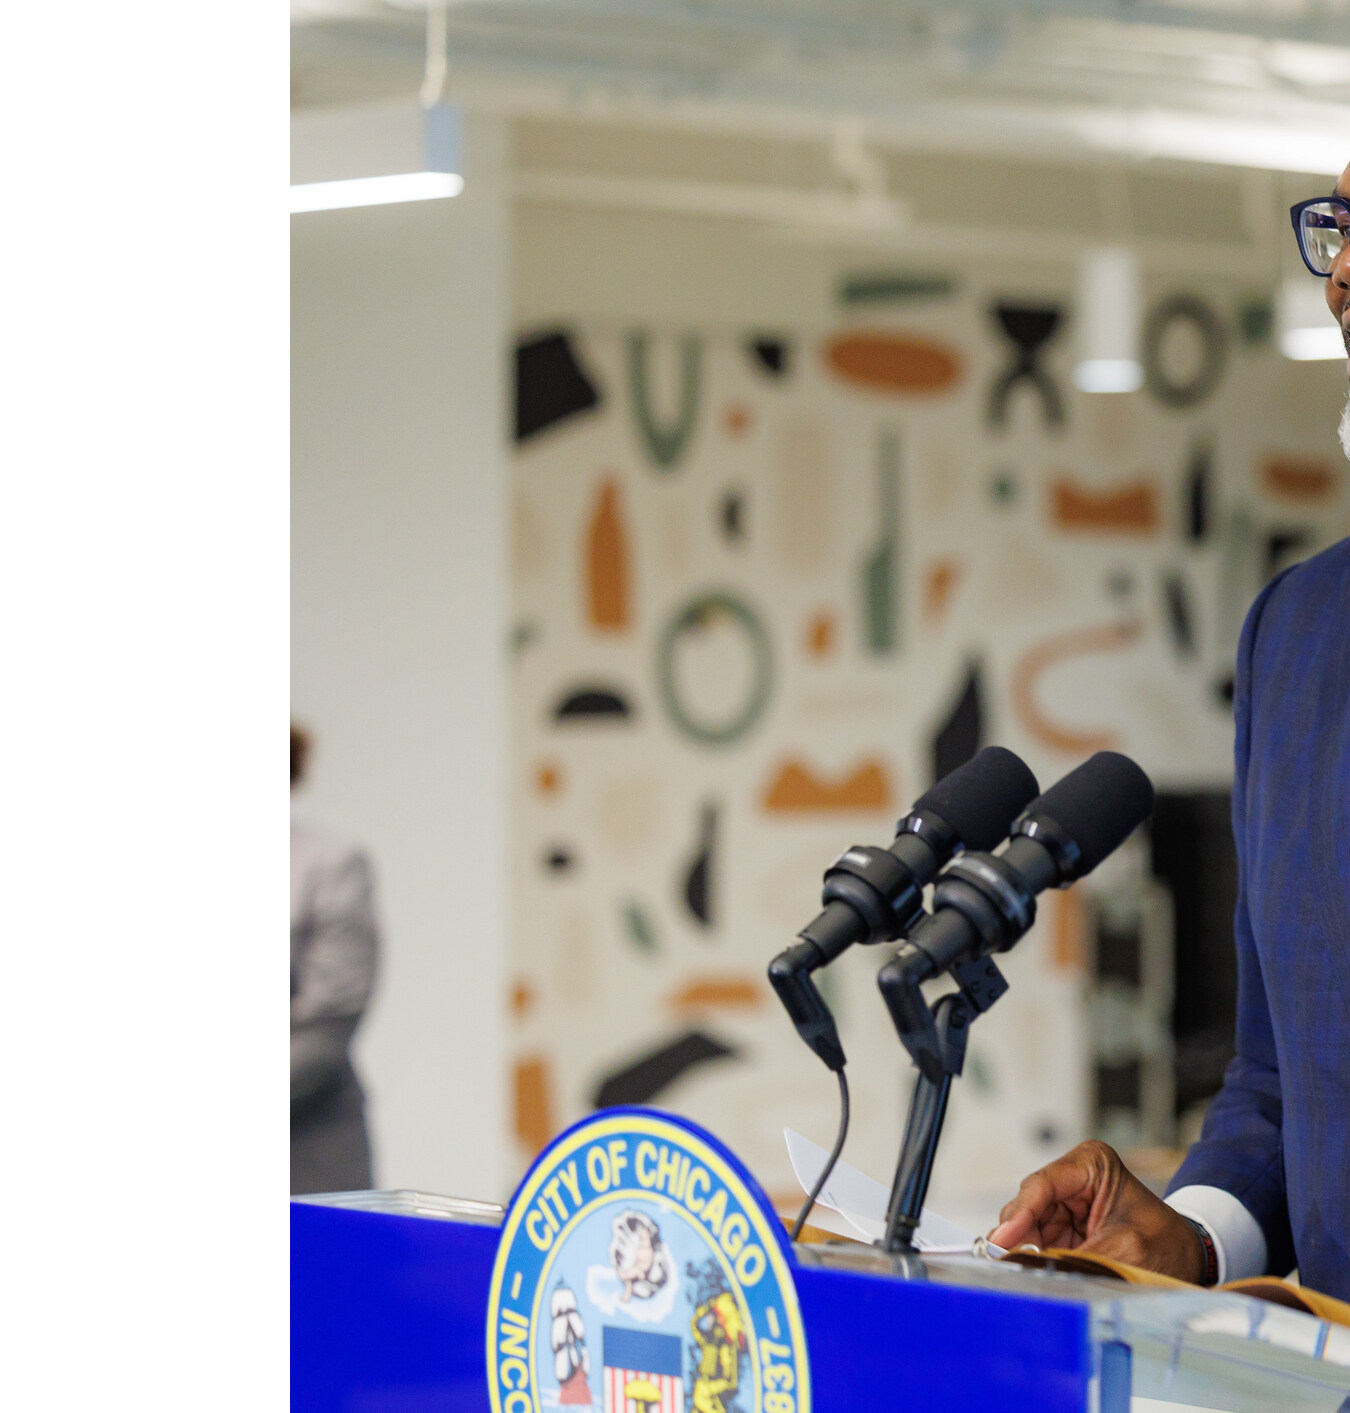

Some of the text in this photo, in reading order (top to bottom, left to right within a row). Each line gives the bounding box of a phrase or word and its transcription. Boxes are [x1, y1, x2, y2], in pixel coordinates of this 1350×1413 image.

[525, 1139, 767, 1287] CITY OF CHICAGO
